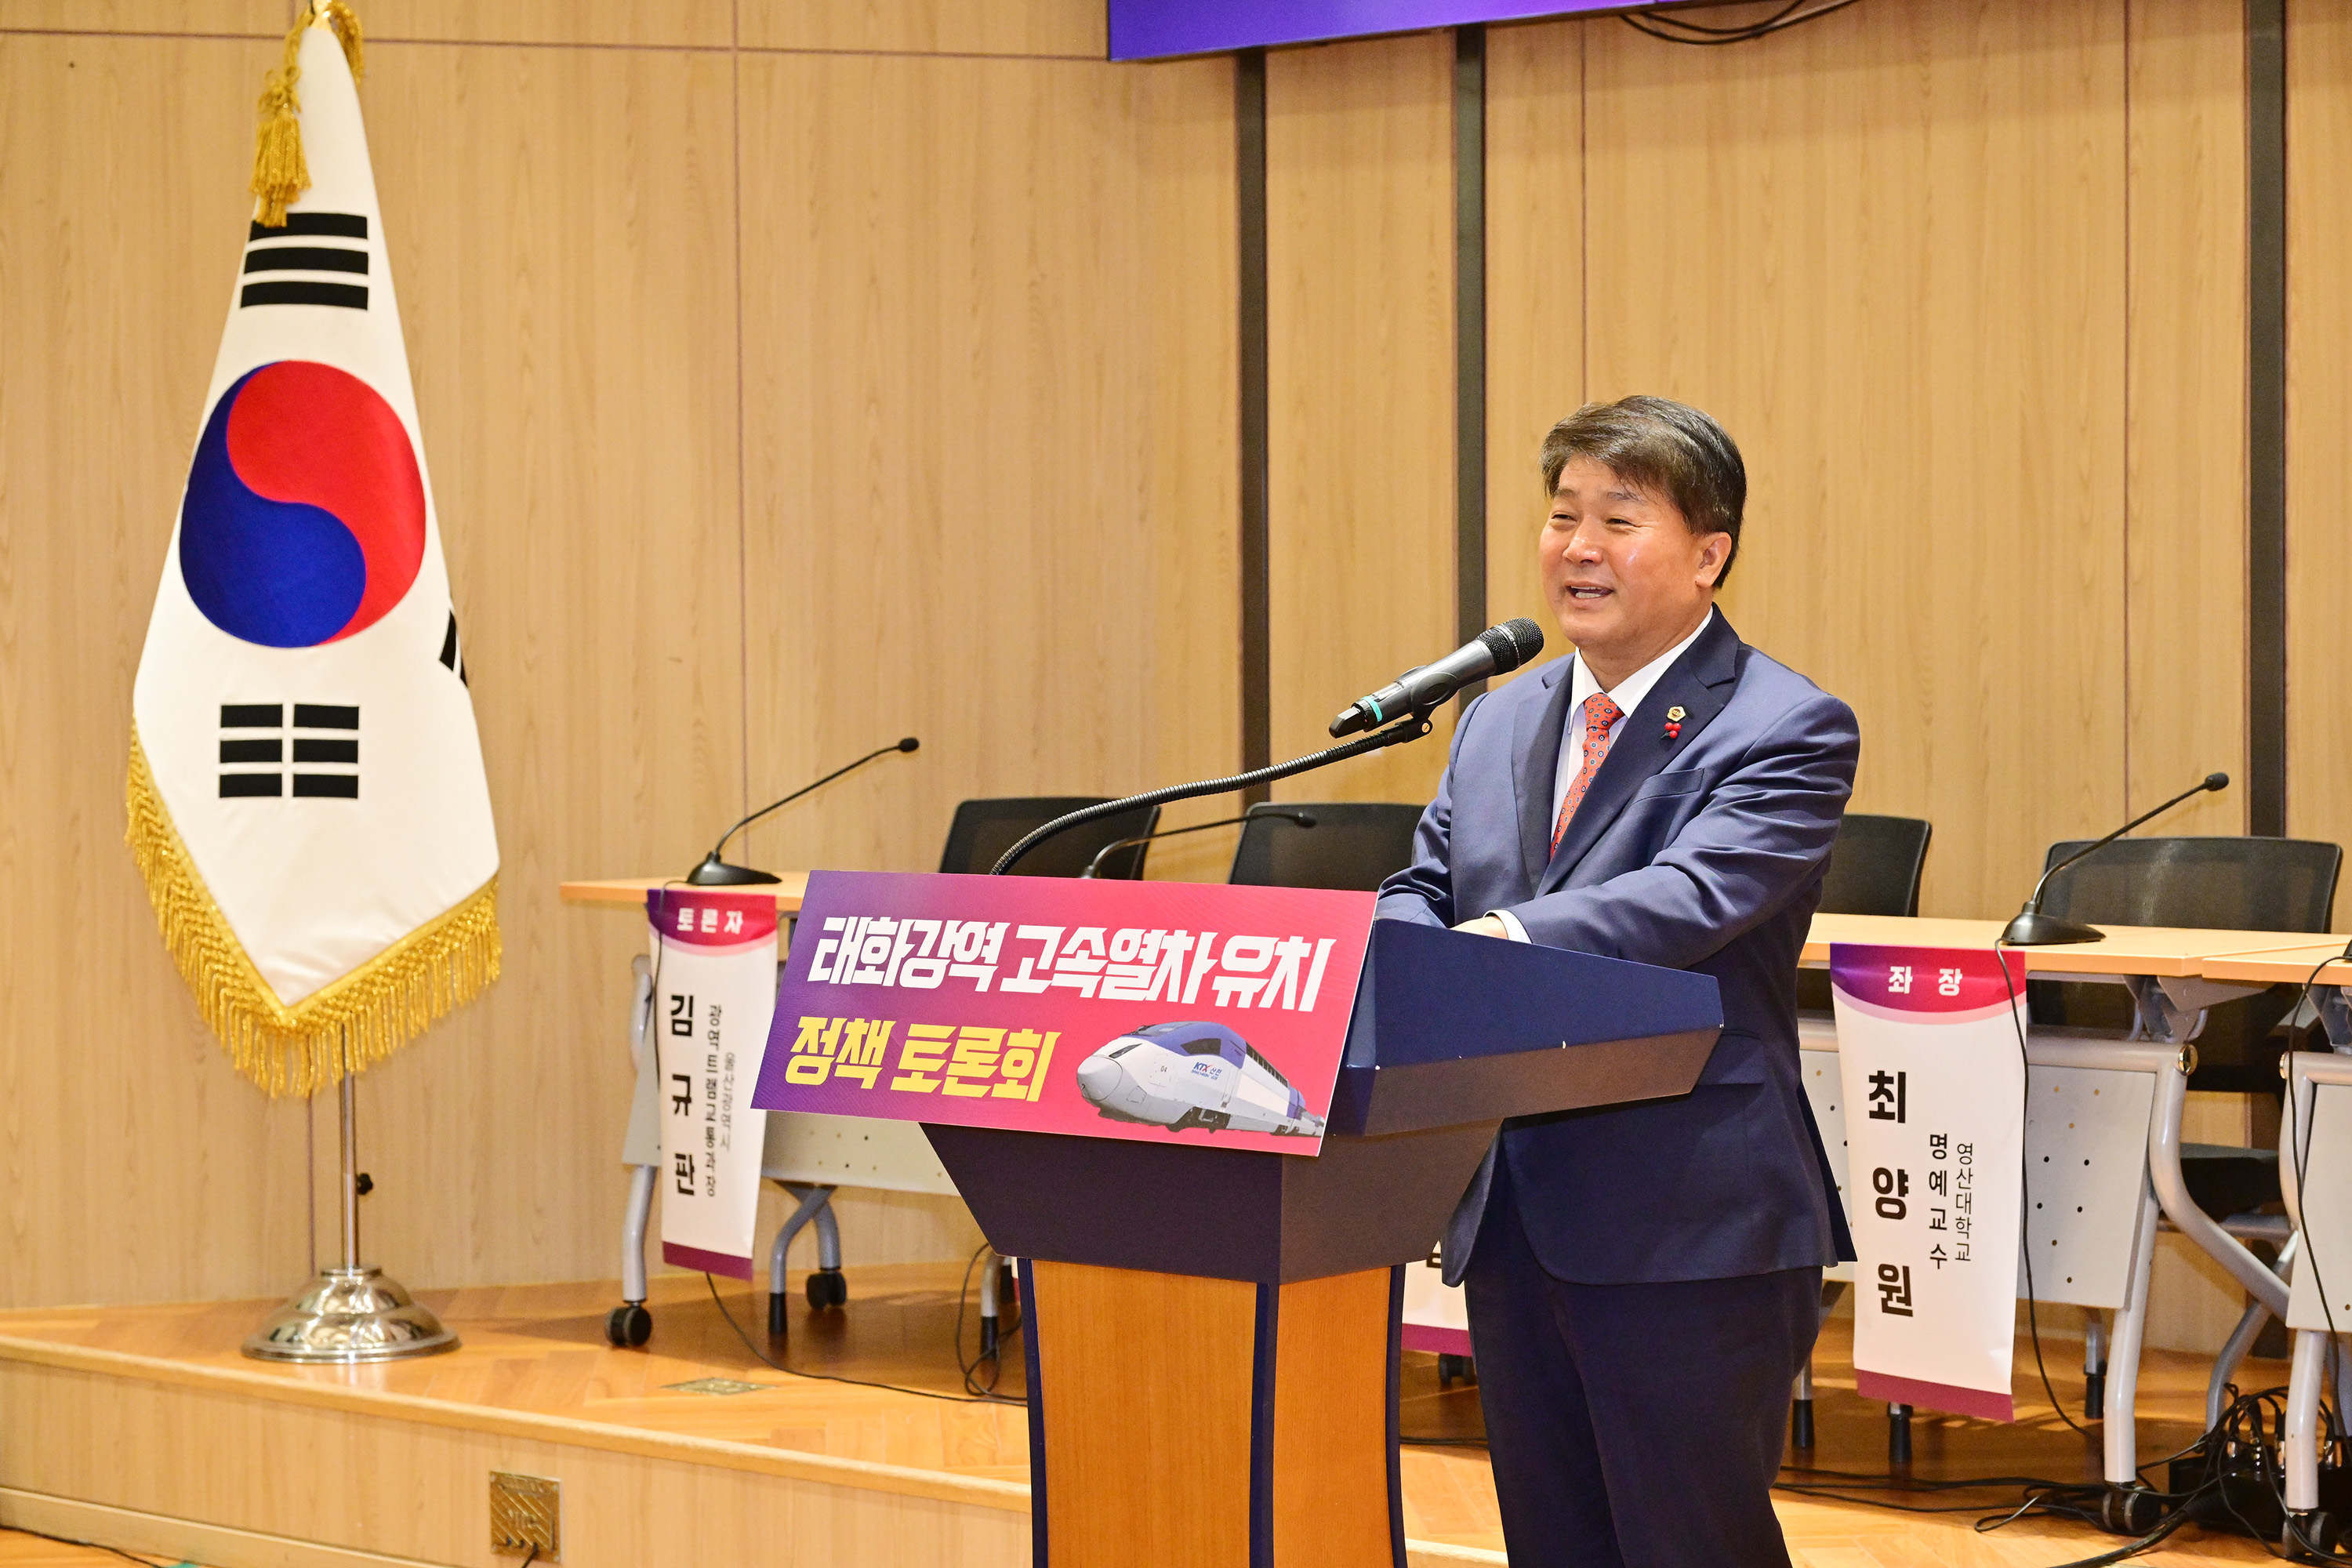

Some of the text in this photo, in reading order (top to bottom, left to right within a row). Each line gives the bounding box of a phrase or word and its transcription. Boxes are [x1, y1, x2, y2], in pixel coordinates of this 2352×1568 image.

[677, 907, 744, 935] 토론자
[807, 916, 1338, 1012] 태화강역 고속열차 유치
[1887, 965, 1963, 996] 좌장
[670, 993, 695, 1196] 김규판
[786, 1016, 1062, 1102] 정책 토론회
[1193, 1061, 1212, 1073] KTX
[1867, 1069, 1915, 1318] 최양원
[1929, 1132, 1948, 1271] 명예교수
[1955, 1142, 1974, 1263] 영산대학교
